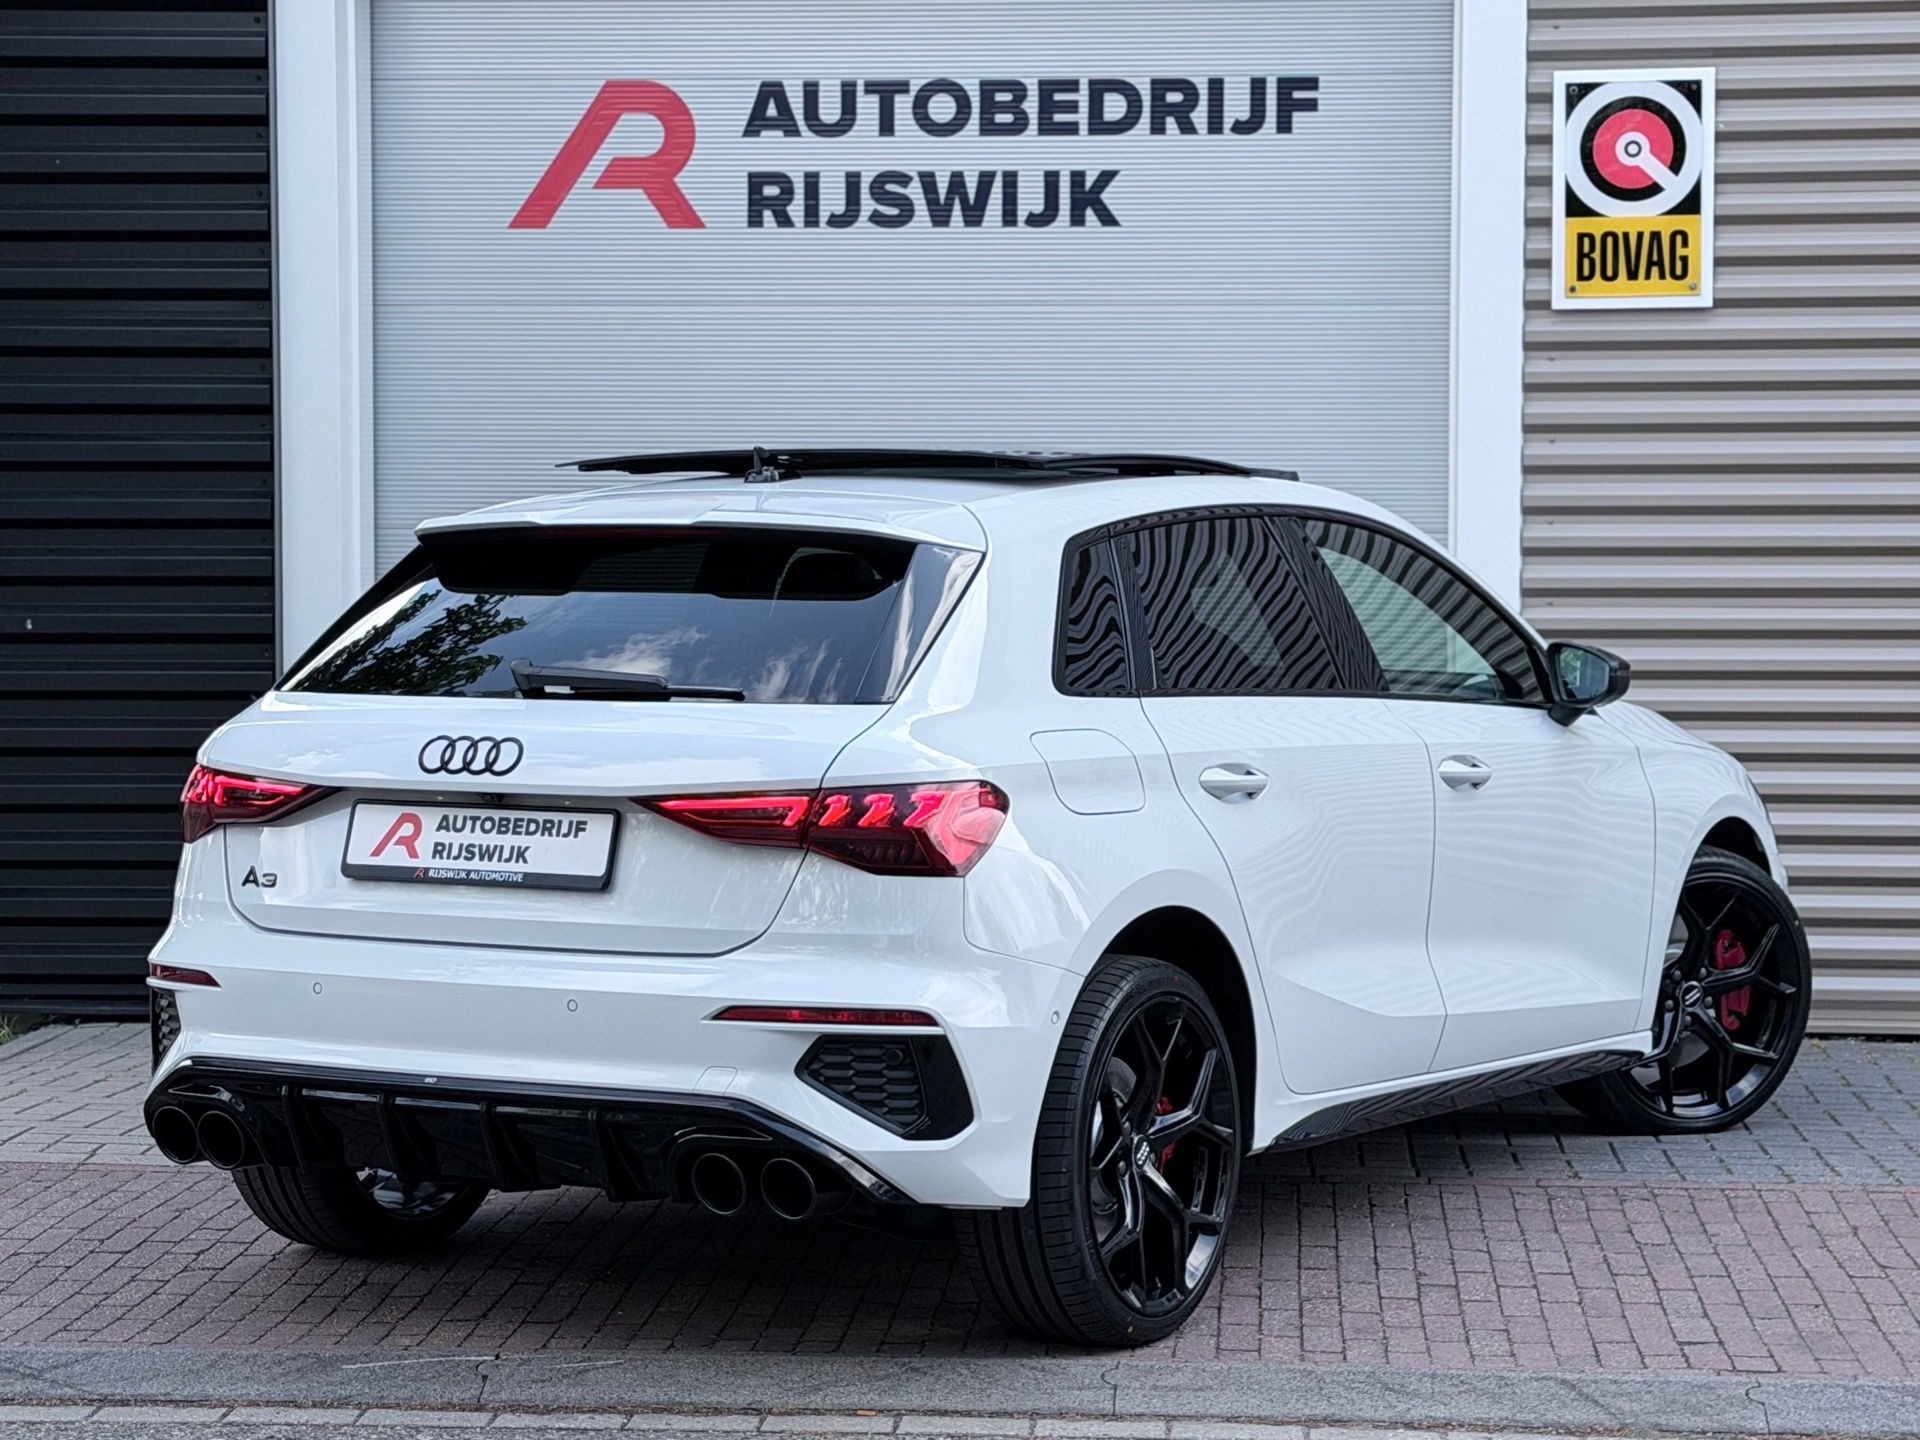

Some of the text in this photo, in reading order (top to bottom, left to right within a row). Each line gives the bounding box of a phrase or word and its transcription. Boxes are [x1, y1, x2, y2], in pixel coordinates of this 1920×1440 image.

[743, 77, 1320, 138] AUTOBEDRIJF
[747, 170, 1122, 228] RIJSWIJK
[1577, 229, 1689, 282] BOVAG
[435, 814, 588, 839] AUTOBEDRIJF
[431, 842, 531, 864] RIJSWIJK
[241, 865, 278, 888] A3
[428, 869, 468, 880] RIJSWIJK
[469, 872, 524, 882] AUTOMOTIVE
